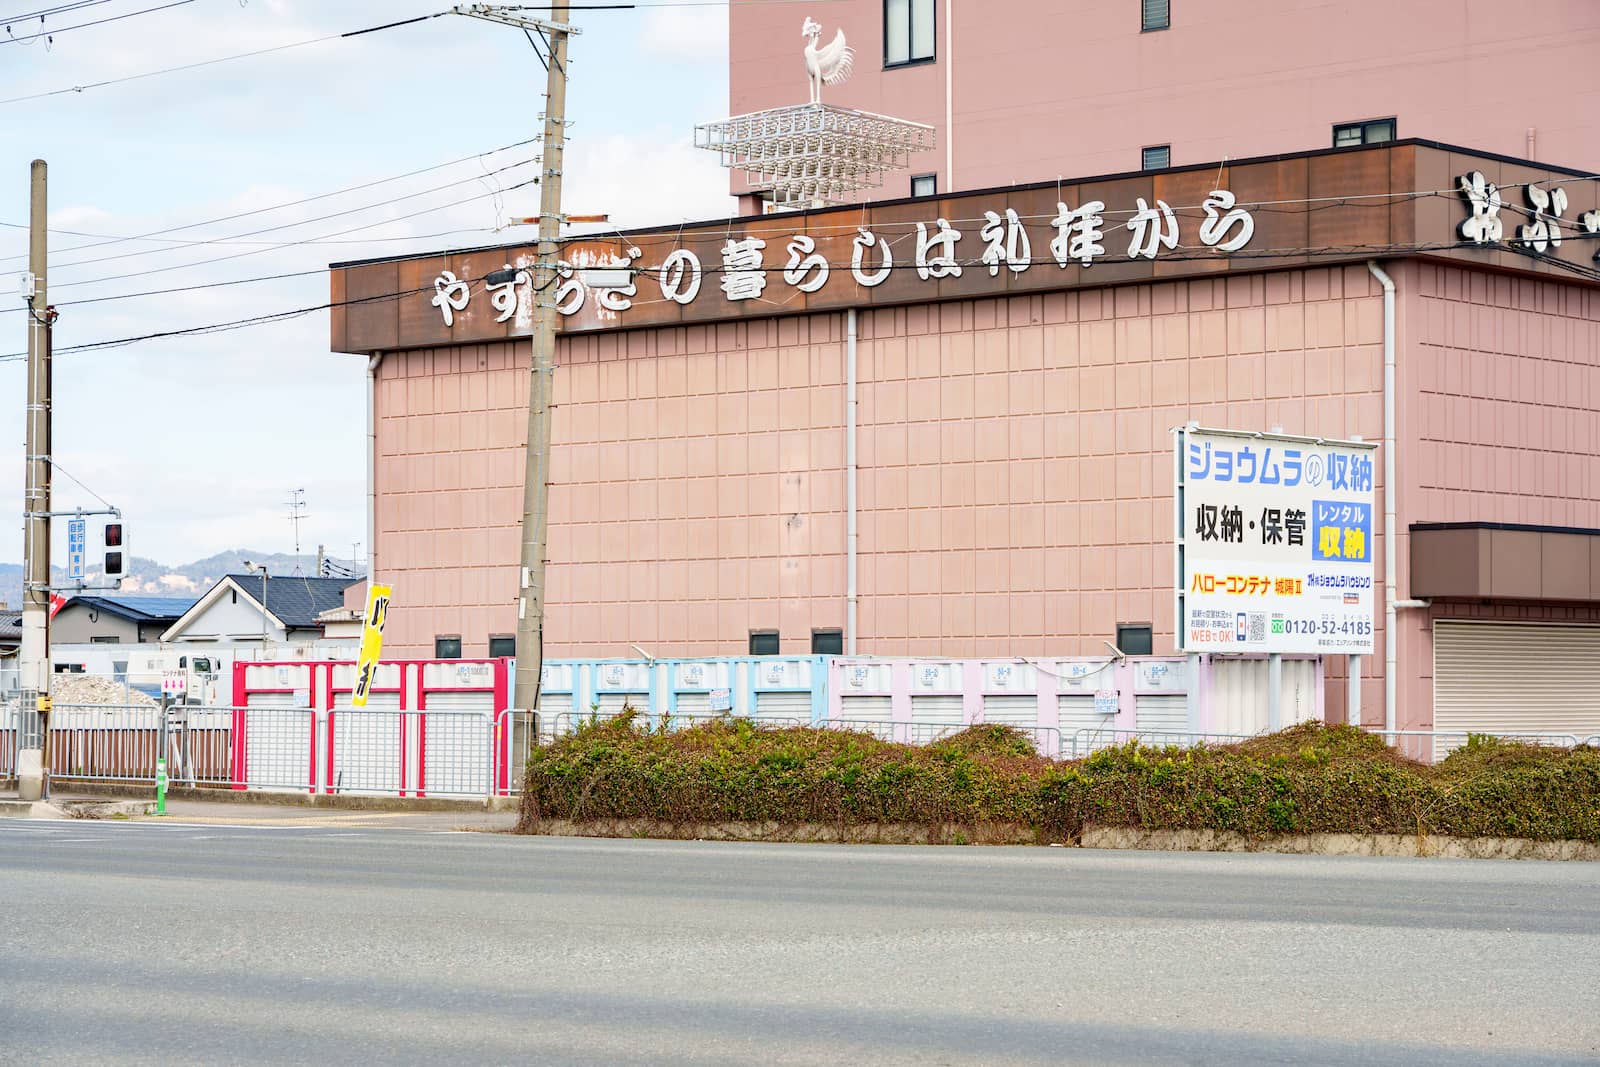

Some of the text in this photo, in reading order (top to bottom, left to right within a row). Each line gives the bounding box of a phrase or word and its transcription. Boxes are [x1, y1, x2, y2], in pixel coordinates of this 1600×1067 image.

[1190, 442, 1372, 492] ジョウムラの収納
[1195, 503, 1306, 546] 収納・保管
[1319, 505, 1364, 524] レンタル
[1318, 526, 1366, 560] 収納
[1191, 573, 1271, 596] ハローコンテナ
[1285, 619, 1371, 635] 0120-52-4185
